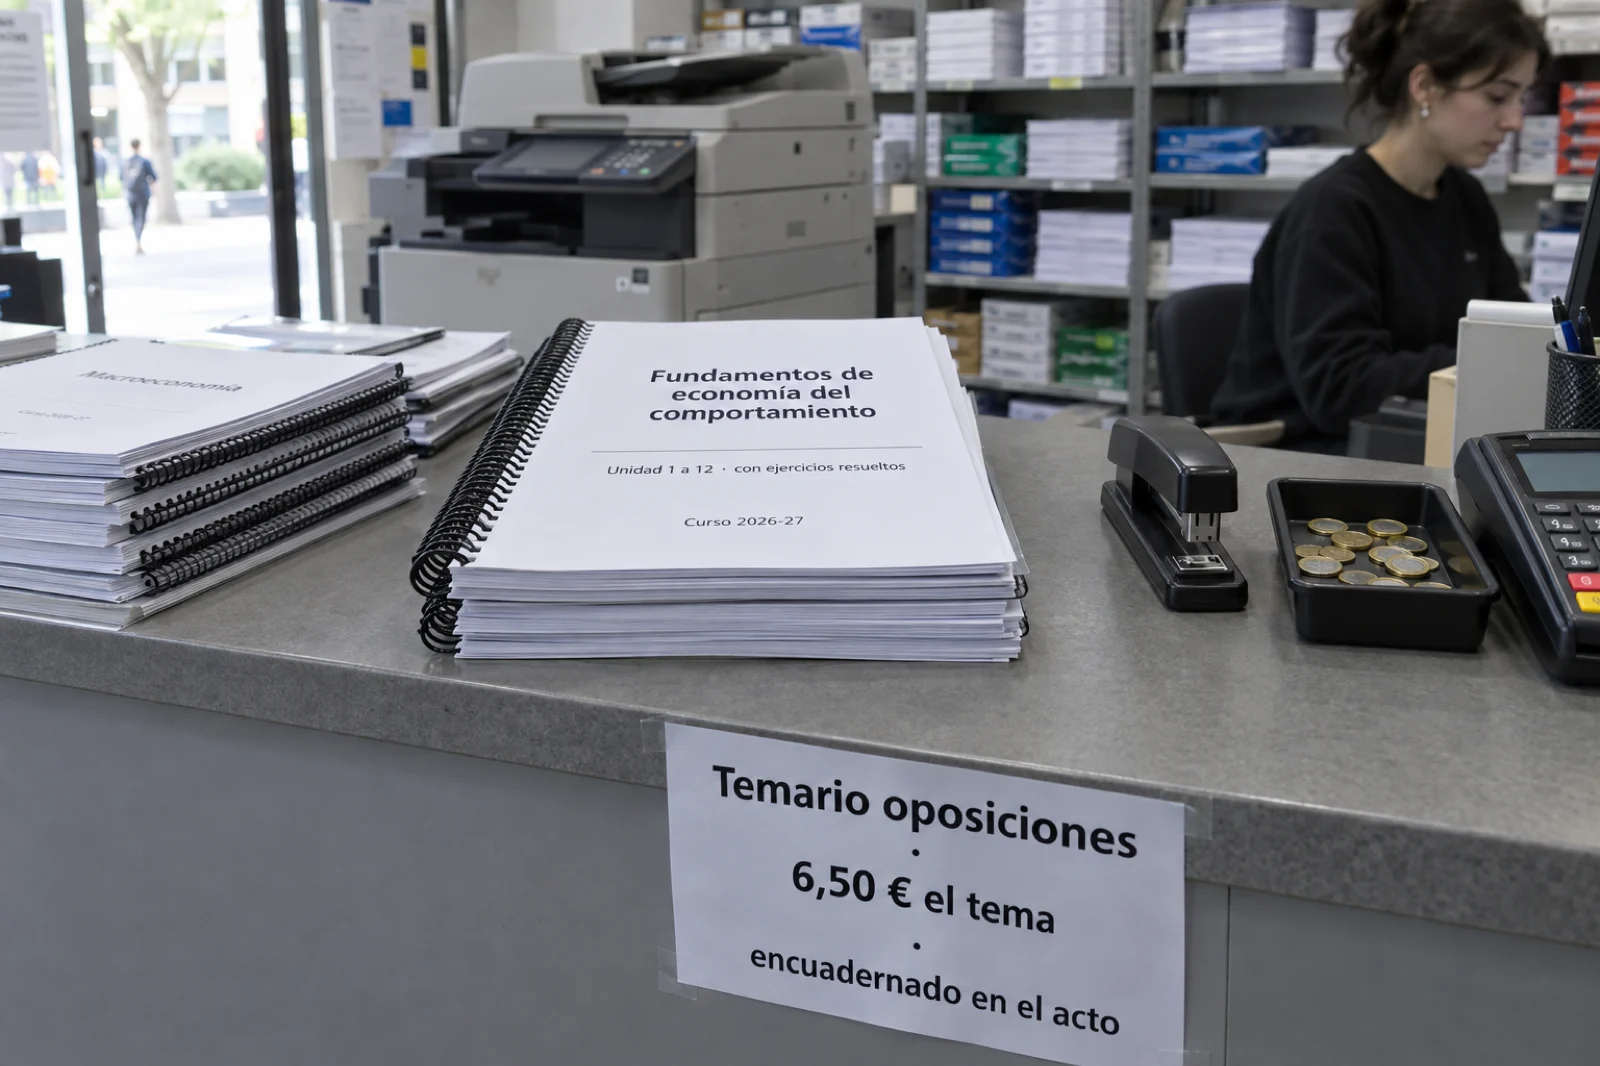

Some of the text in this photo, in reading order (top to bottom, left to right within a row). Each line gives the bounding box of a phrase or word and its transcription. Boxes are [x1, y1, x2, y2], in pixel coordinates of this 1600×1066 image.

[650, 366, 874, 383] Fundamentos de
[671, 384, 851, 402] economía del
[649, 404, 877, 424] comportamiento
[607, 464, 663, 475] Unidad
[668, 464, 676, 475] 1
[681, 466, 690, 475] a
[695, 464, 714, 474] 12
[734, 465, 761, 474] con
[766, 462, 835, 475] ejercicios
[838, 461, 906, 472] resueltos
[684, 515, 804, 528] Curso 2026-27
[712, 764, 1138, 859] Temario oposiciones
[792, 860, 1055, 934] 6,50 € el tema
[750, 949, 1120, 1036] encuadernado en el acto
